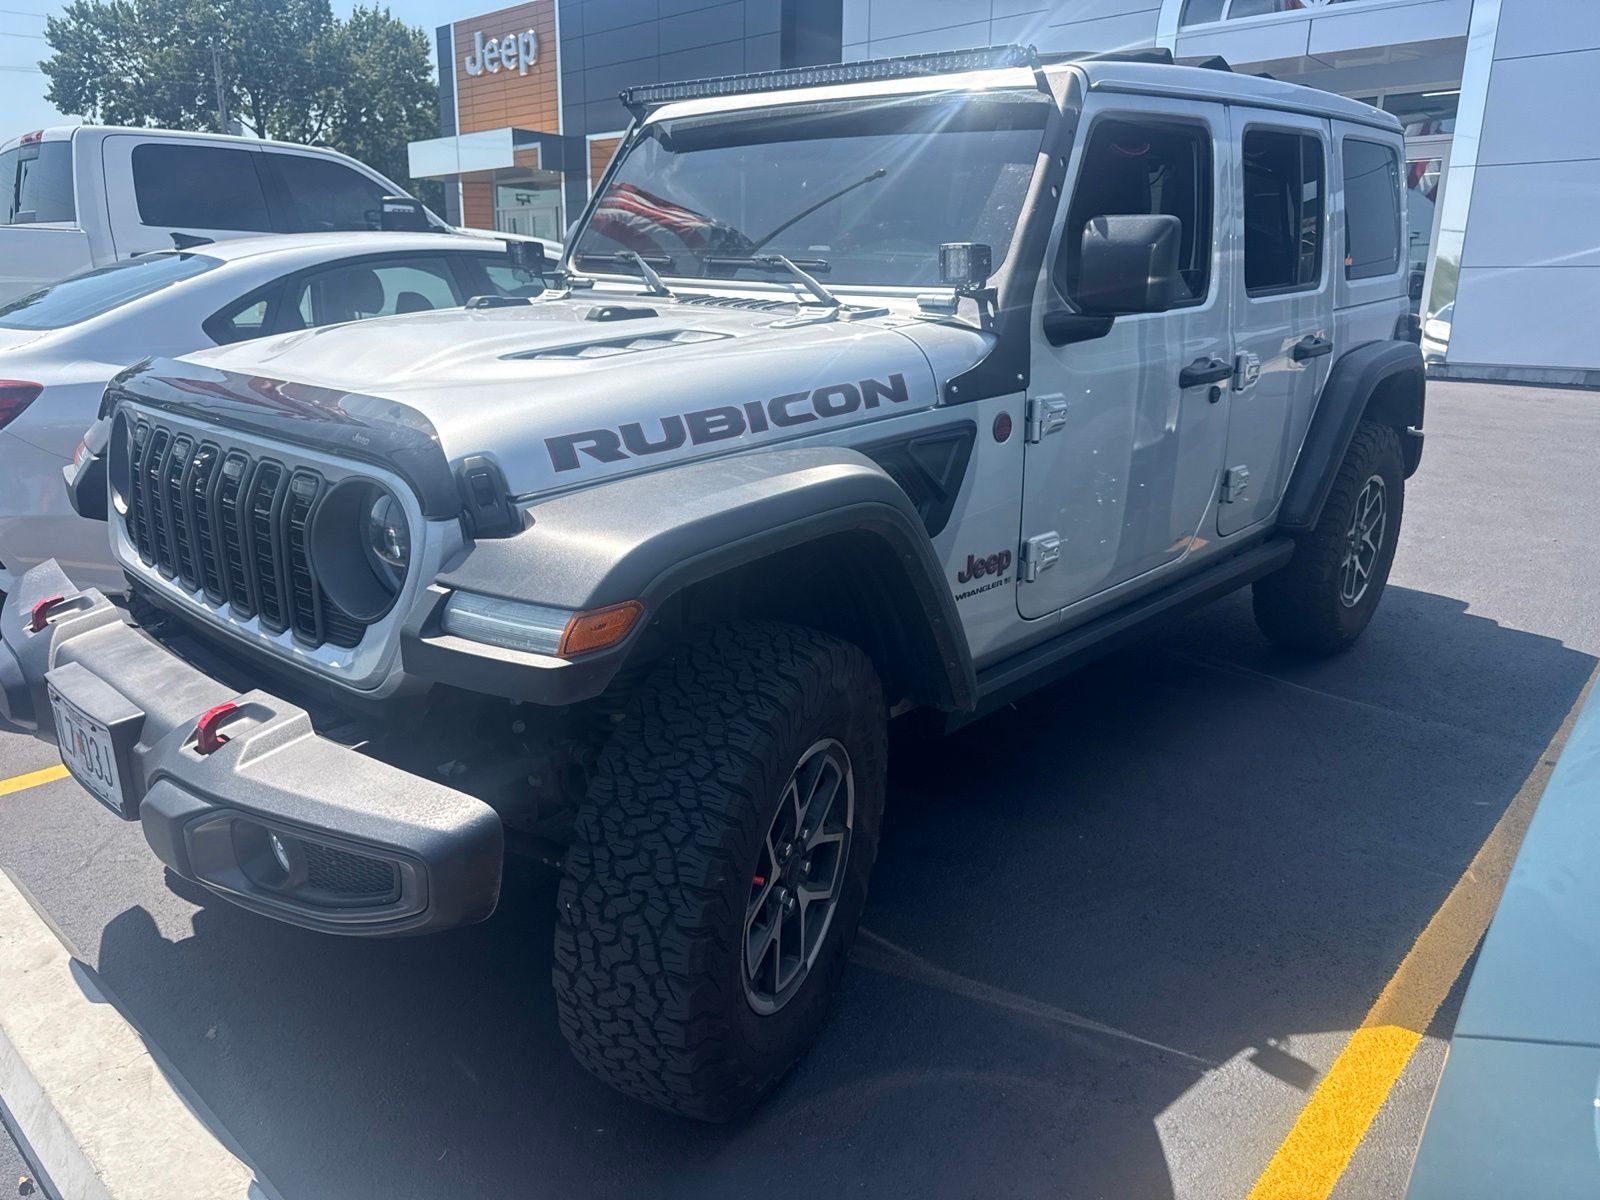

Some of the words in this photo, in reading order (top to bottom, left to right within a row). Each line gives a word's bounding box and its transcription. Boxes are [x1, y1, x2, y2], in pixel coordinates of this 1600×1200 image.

[464, 29, 537, 76] Jeep
[544, 373, 909, 473] RUBICON
[957, 549, 1011, 585] Jeep
[954, 579, 1003, 602] WRANGLER
